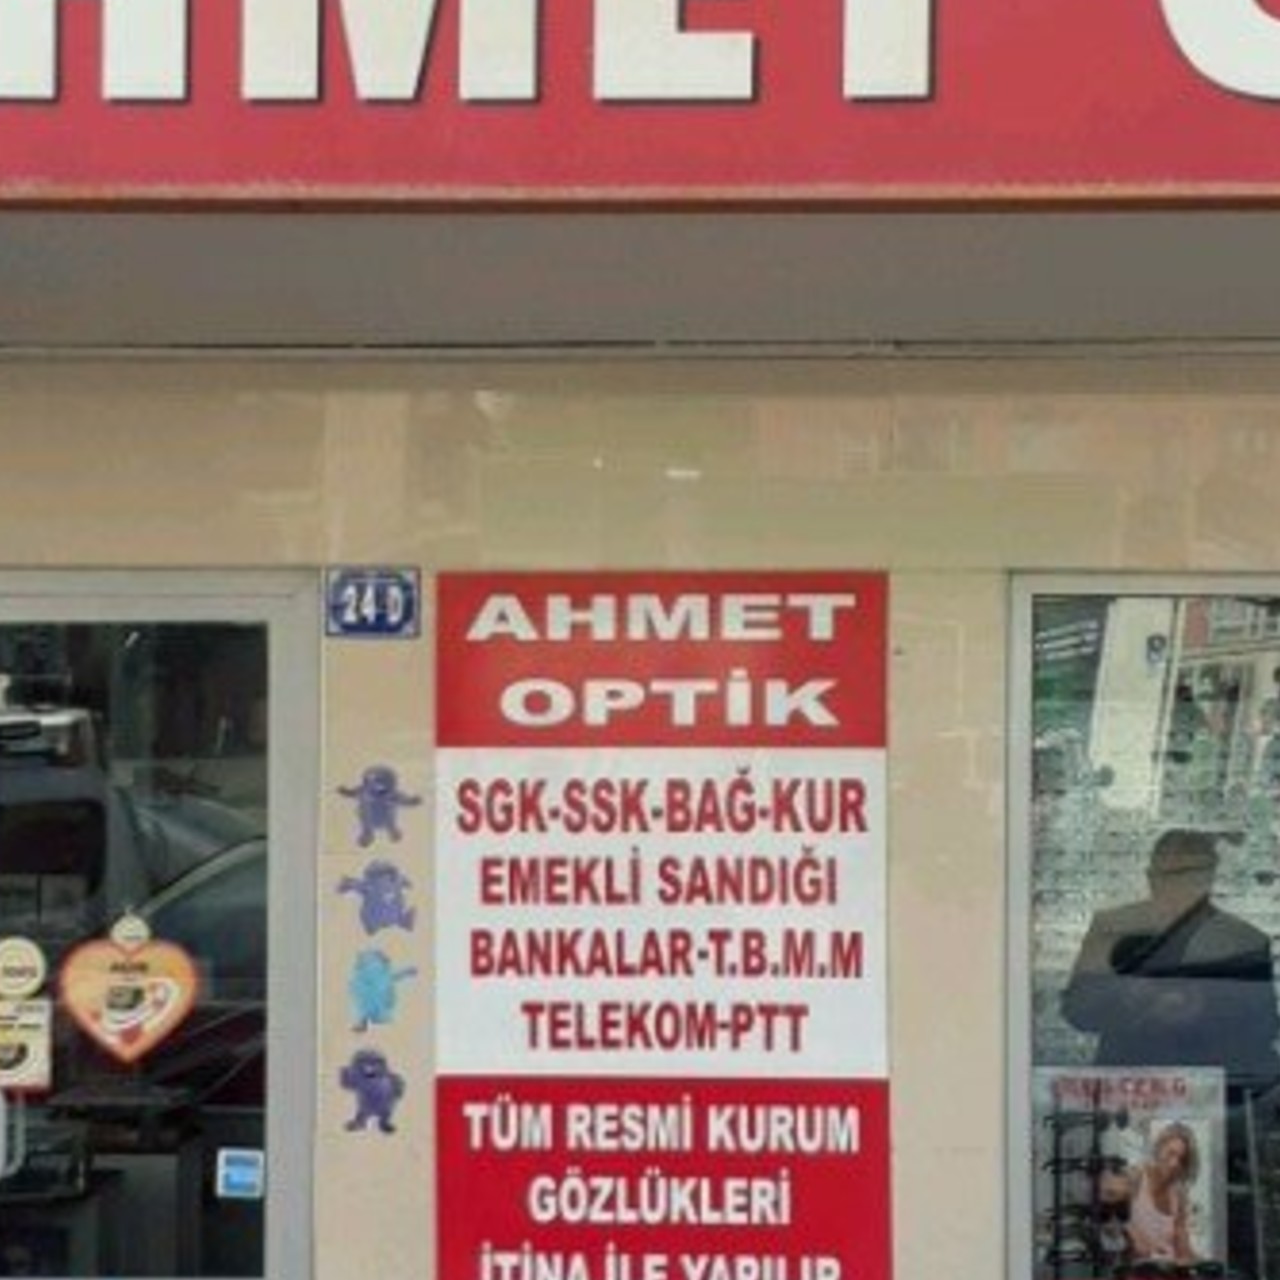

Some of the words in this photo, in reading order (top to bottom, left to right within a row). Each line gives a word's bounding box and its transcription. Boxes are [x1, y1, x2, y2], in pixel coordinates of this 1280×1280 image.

[465, 593, 856, 641] AHMET
[500, 668, 840, 727] OPTİK
[456, 765, 868, 833] SGK-SSK-BAĞ-KUR
[480, 845, 642, 905] EMEKLİ
[657, 845, 837, 905] SANDIĞI
[521, 1001, 808, 1052] TELEKOM-PTT
[463, 1093, 553, 1151] TÜM
[566, 1094, 693, 1152] RESMİ
[707, 1104, 860, 1154] KURUM
[528, 1166, 791, 1226] GÖZLÜKLERİ
